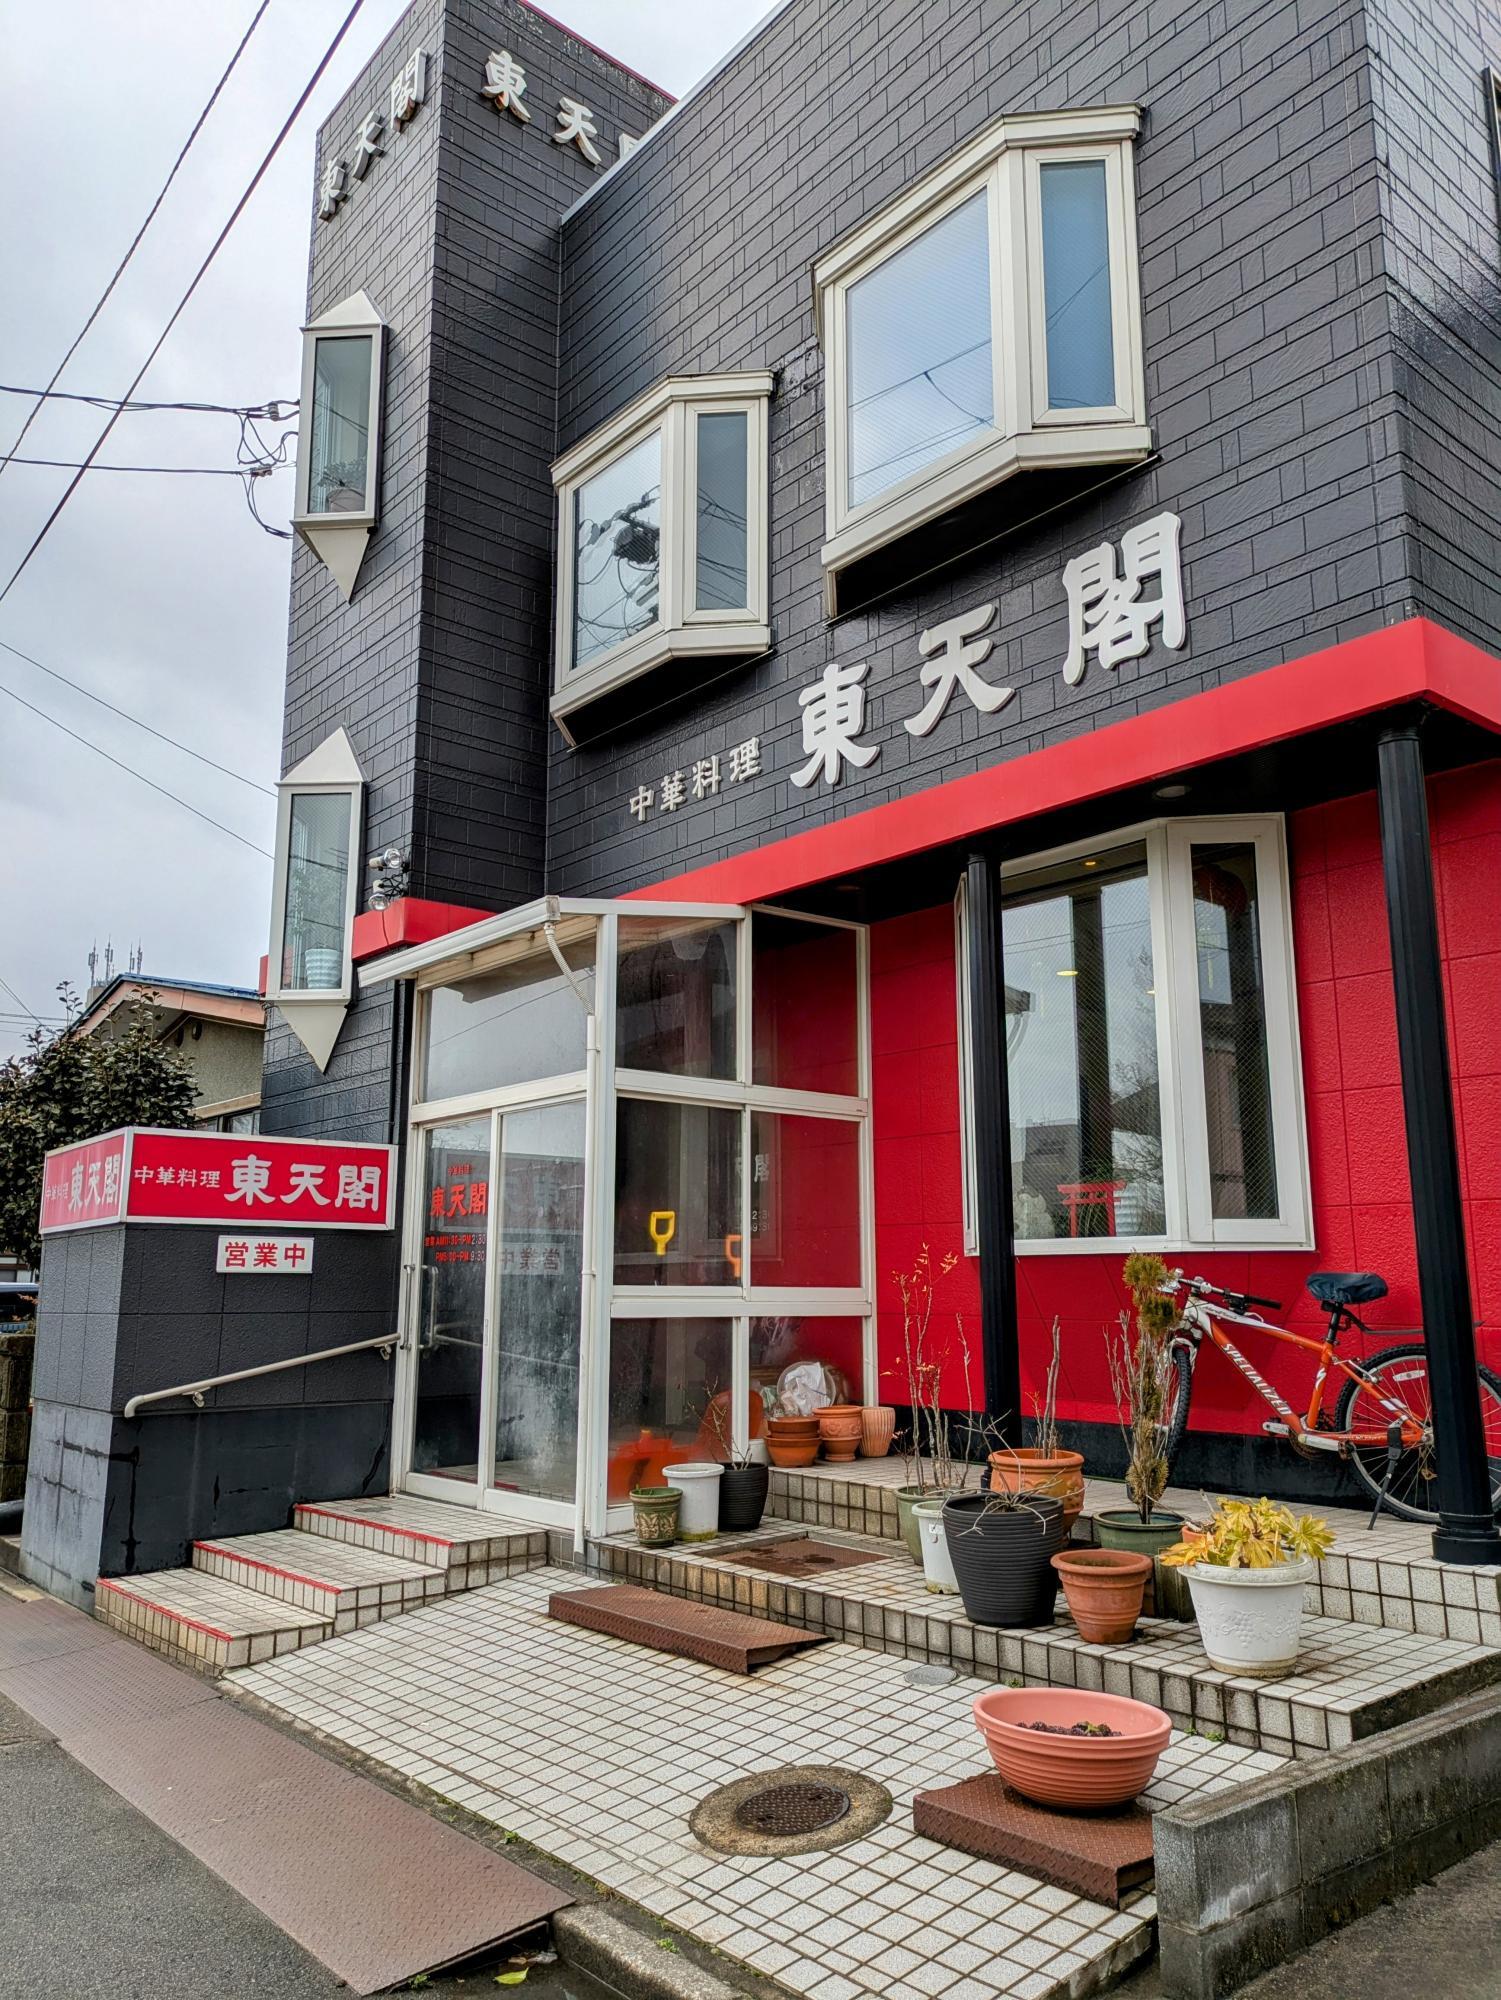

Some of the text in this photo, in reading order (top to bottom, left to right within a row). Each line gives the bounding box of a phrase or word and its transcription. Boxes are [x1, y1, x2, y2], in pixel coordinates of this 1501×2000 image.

[481, 50, 641, 165] 東天
[630, 511, 1187, 821] 中華料理 東天閣
[68, 1153, 121, 1213] 東天閣
[134, 1154, 383, 1212] 中華料理 東天閣
[430, 1182, 488, 1217] 東天閣
[224, 1241, 306, 1268] 営業中
[1223, 1342, 1292, 1416] SPECIALIZED
